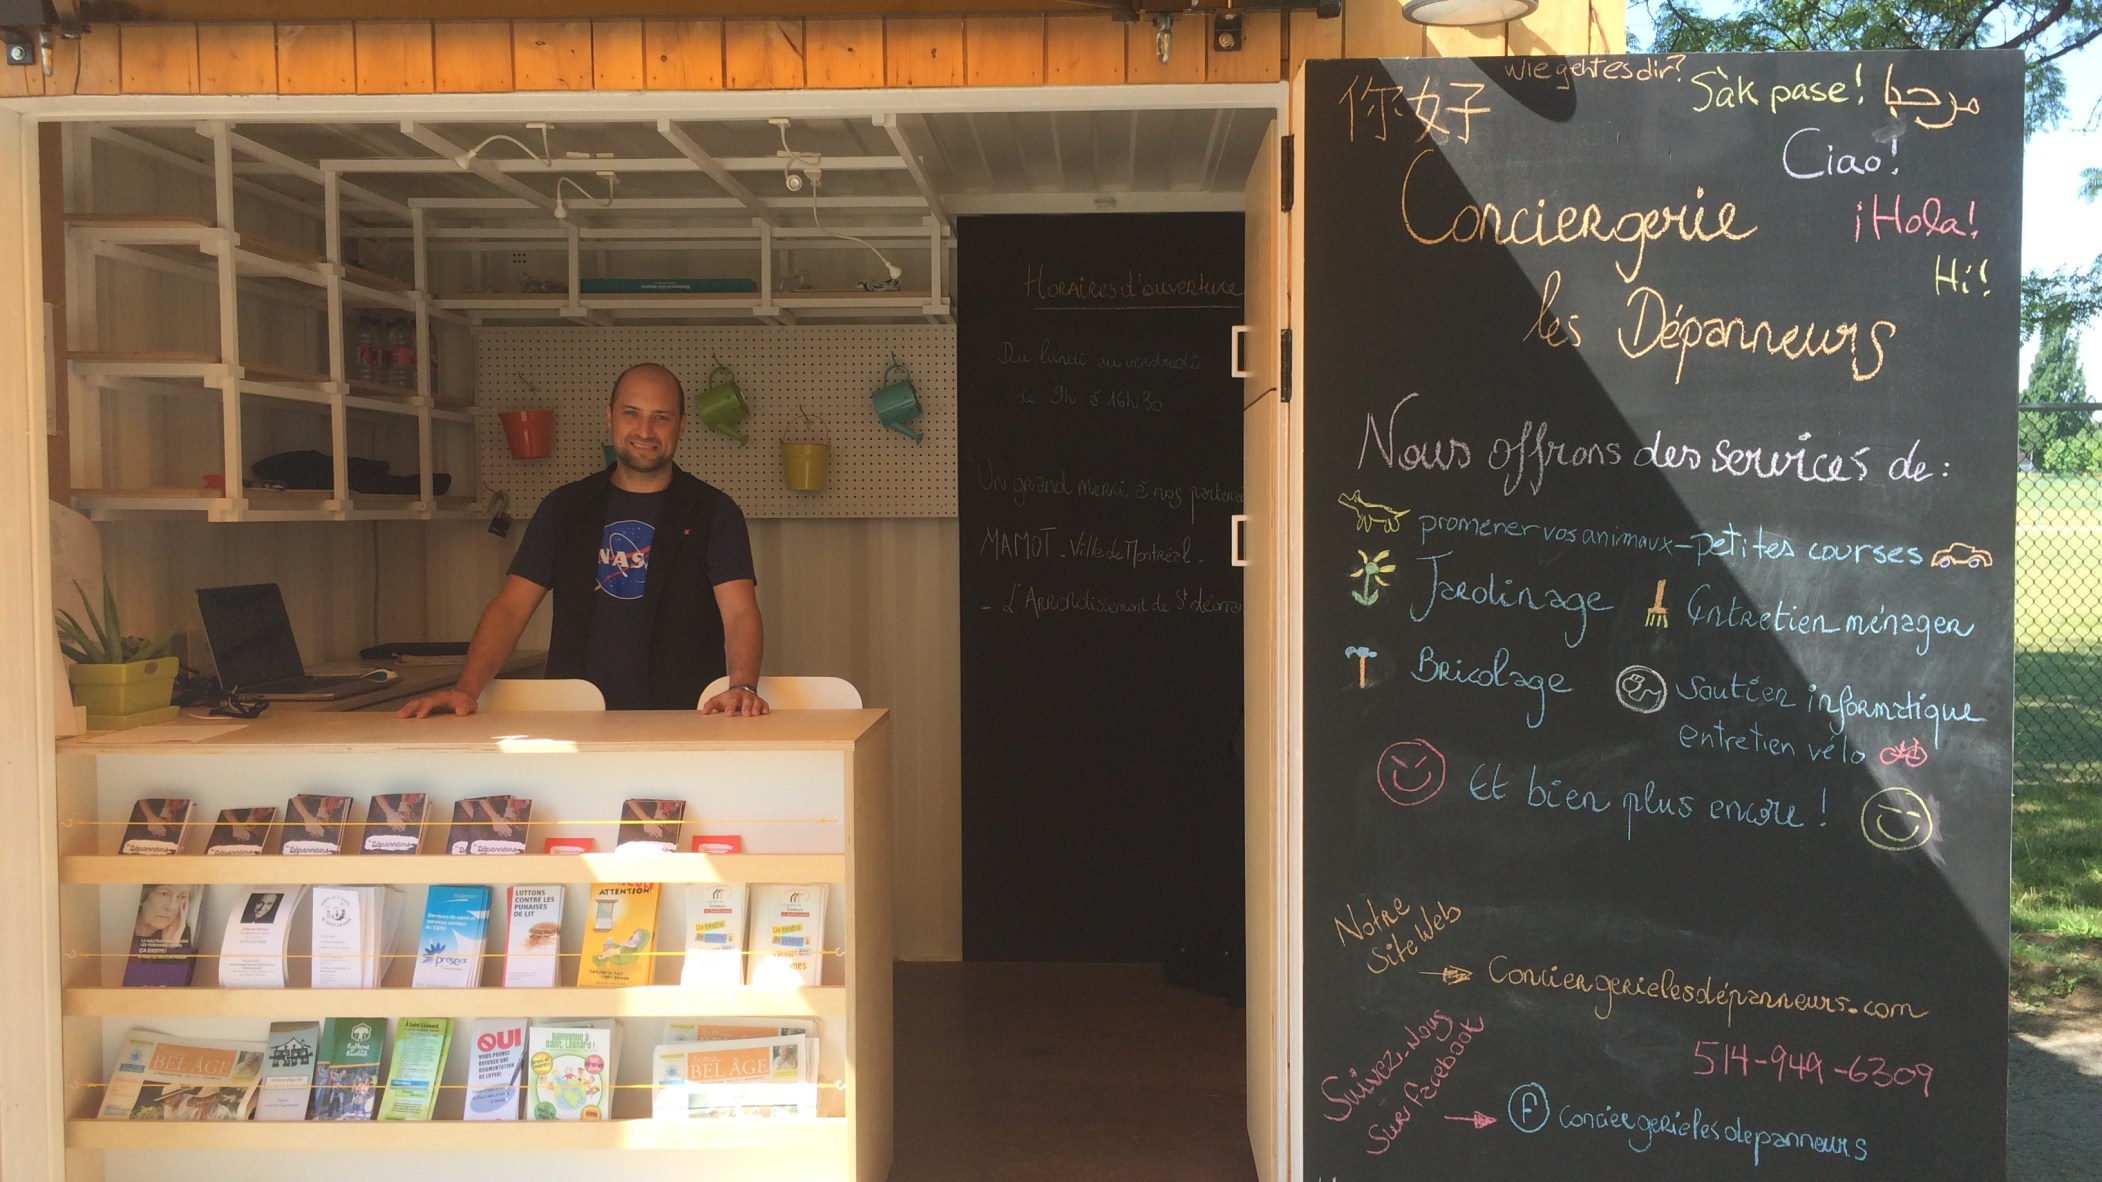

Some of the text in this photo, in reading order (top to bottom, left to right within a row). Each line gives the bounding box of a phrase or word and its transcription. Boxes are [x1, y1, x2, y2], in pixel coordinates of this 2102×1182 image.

[1339, 75, 1491, 145] 你好
[1783, 127, 1900, 179] Ciao!
[1402, 149, 1758, 283] Conciergerie
[1935, 254, 1991, 297] Hi!
[1618, 286, 1896, 385] Dépanneurs
[1357, 392, 1471, 471] Nous
[1488, 420, 1622, 496] offrons
[1633, 430, 1701, 470] des
[1712, 432, 1861, 482] services
[1418, 515, 1539, 546] promener
[1542, 526, 1577, 544] vos
[1808, 541, 1924, 566] courses
[1410, 551, 1615, 648] Jardinage
[1845, 605, 1975, 656] ménager
[1410, 646, 1575, 729] Bricolage
[1679, 720, 1866, 764] entretien vélo
[1807, 683, 1988, 750] informatique
[1469, 763, 1508, 801] Et
[1526, 765, 1611, 813] bien
[1622, 781, 1694, 841] plus
[599, 887, 651, 896] ATTENTION
[1334, 897, 1411, 947] Notre
[153, 1054, 231, 1075] BEL ÂGE
[477, 1028, 521, 1052] OUI
[690, 1057, 769, 1080] BEL ÂGE
[1693, 1040, 1934, 1098] 514-949-6309
